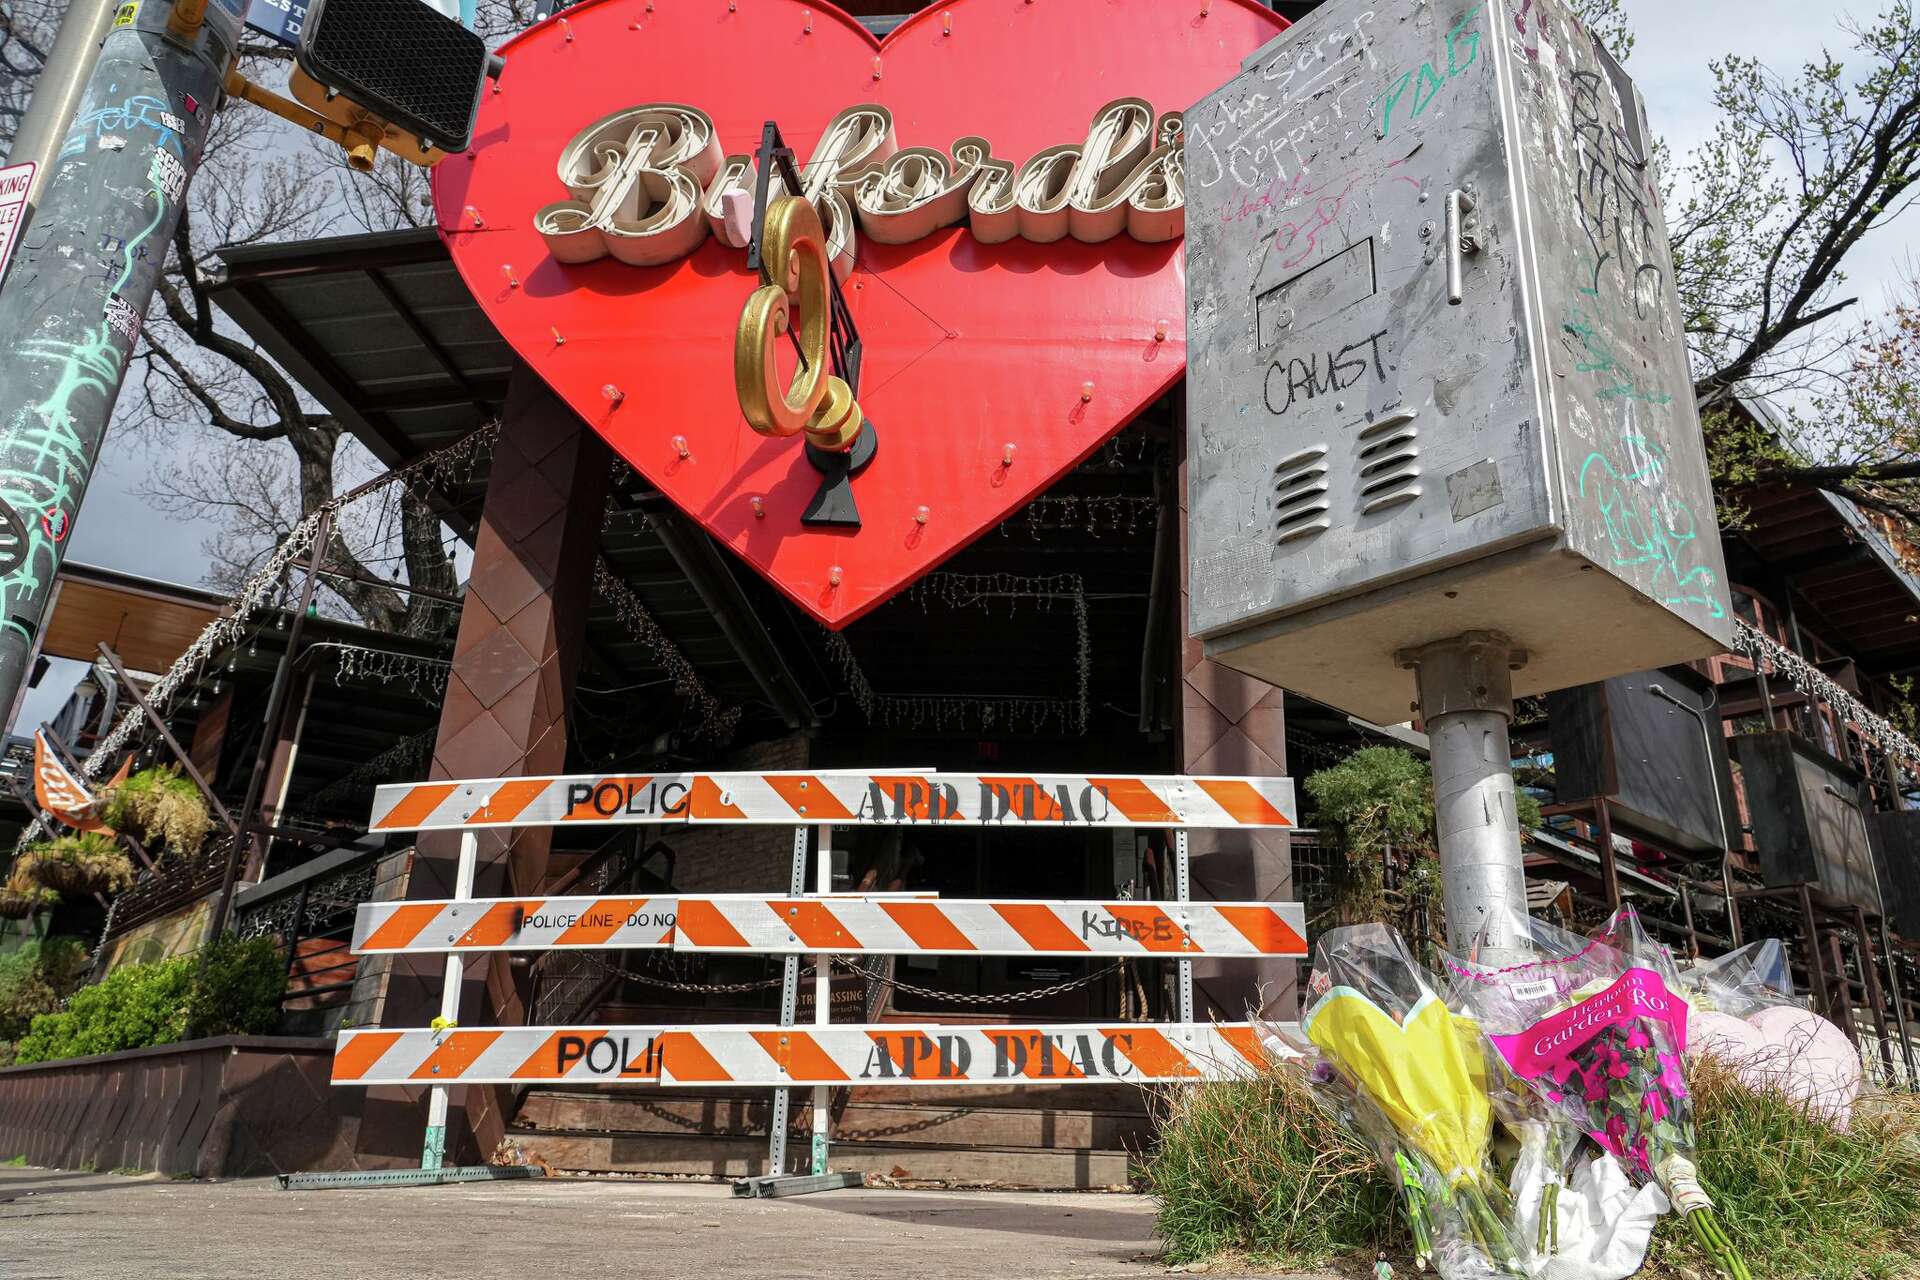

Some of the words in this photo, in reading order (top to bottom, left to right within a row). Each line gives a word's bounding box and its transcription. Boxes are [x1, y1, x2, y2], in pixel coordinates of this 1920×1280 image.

[857, 782, 959, 822] APD
[978, 783, 1109, 823] DTAC
[523, 914, 577, 929] POLICE
[580, 914, 614, 927] LINE
[627, 913, 649, 927] DO
[653, 913, 676, 927] NO
[1534, 1004, 1622, 1056] Garden
[557, 1036, 663, 1074] POLI
[859, 1035, 972, 1078] APD
[993, 1034, 1133, 1078] DTAC
